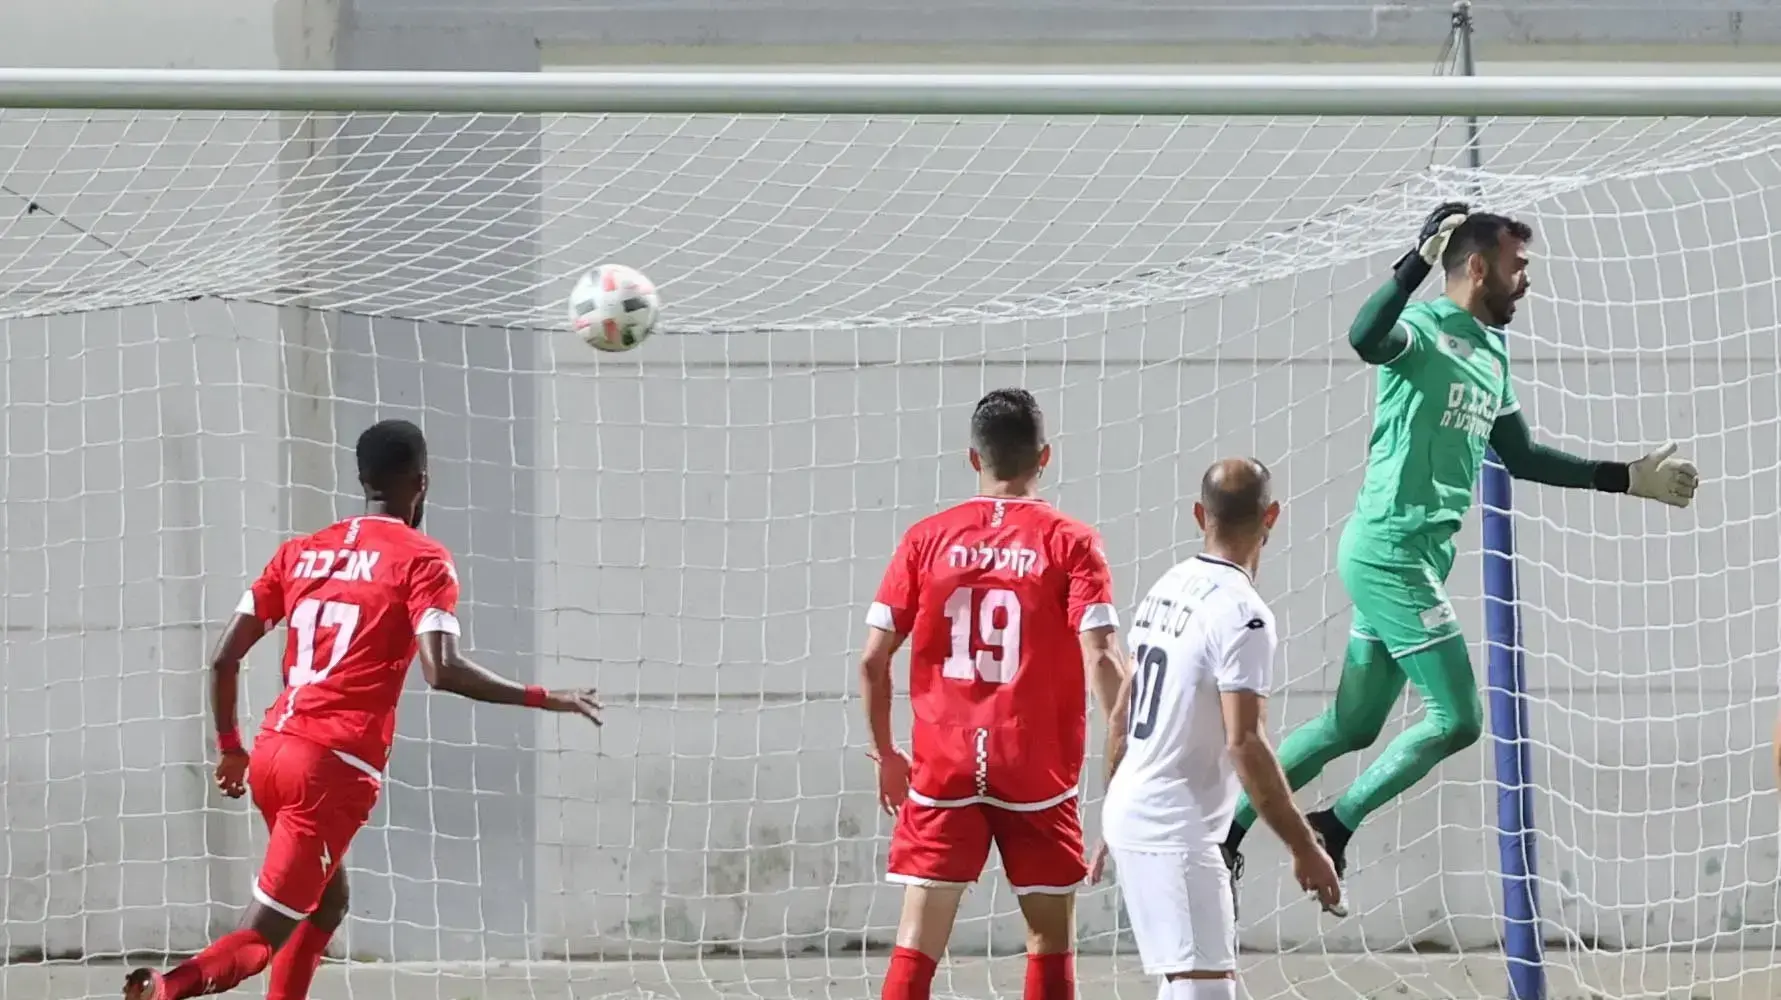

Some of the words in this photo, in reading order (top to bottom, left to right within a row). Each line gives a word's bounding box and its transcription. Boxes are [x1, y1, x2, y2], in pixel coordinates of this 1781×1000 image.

[288, 598, 360, 688] 17
[942, 586, 1022, 685] 19
[1128, 643, 1168, 741] 10
